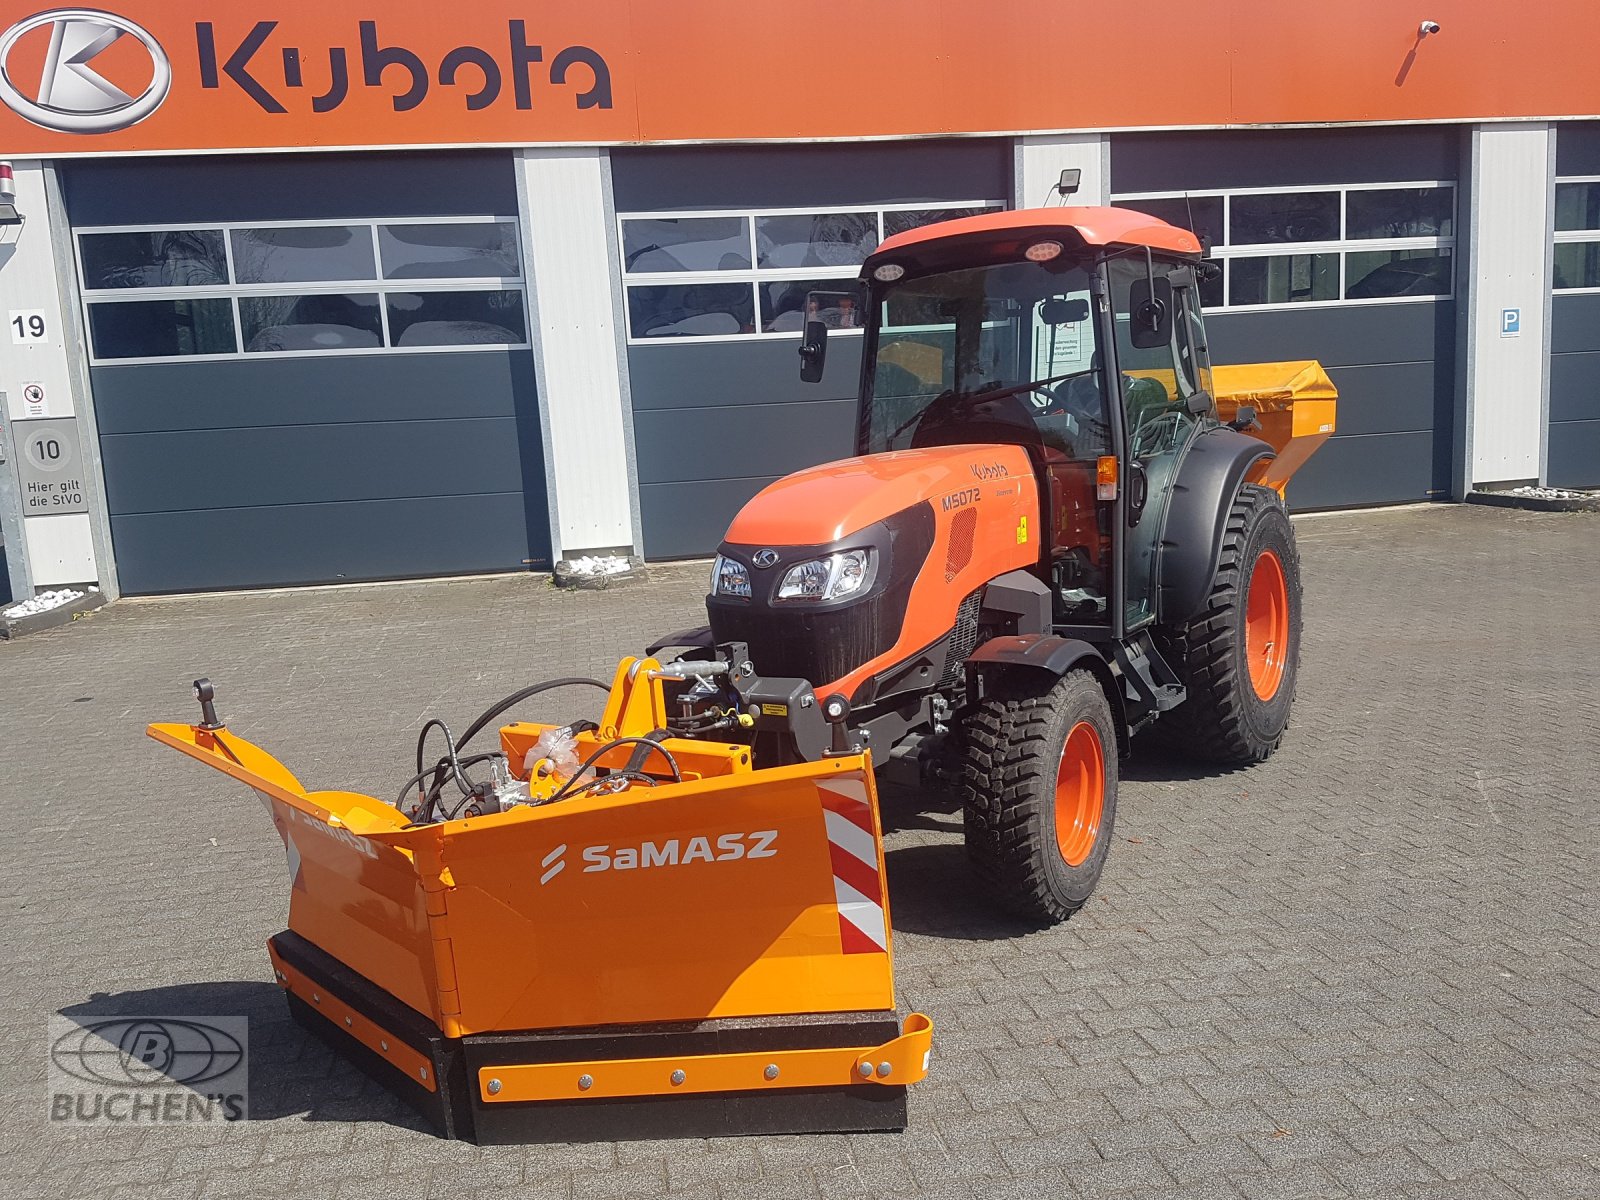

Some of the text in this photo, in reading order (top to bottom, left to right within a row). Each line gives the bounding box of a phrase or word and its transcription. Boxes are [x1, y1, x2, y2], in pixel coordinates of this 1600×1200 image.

[195, 19, 613, 114] Kubota
[12, 314, 45, 338] 19
[1504, 311, 1518, 331] P
[36, 439, 60, 460] 10
[970, 461, 1009, 480] Kubota
[27, 479, 80, 493] Hier gilt
[29, 493, 82, 507] die StVO
[941, 487, 981, 513] M5072
[582, 829, 778, 873] SaMASZ
